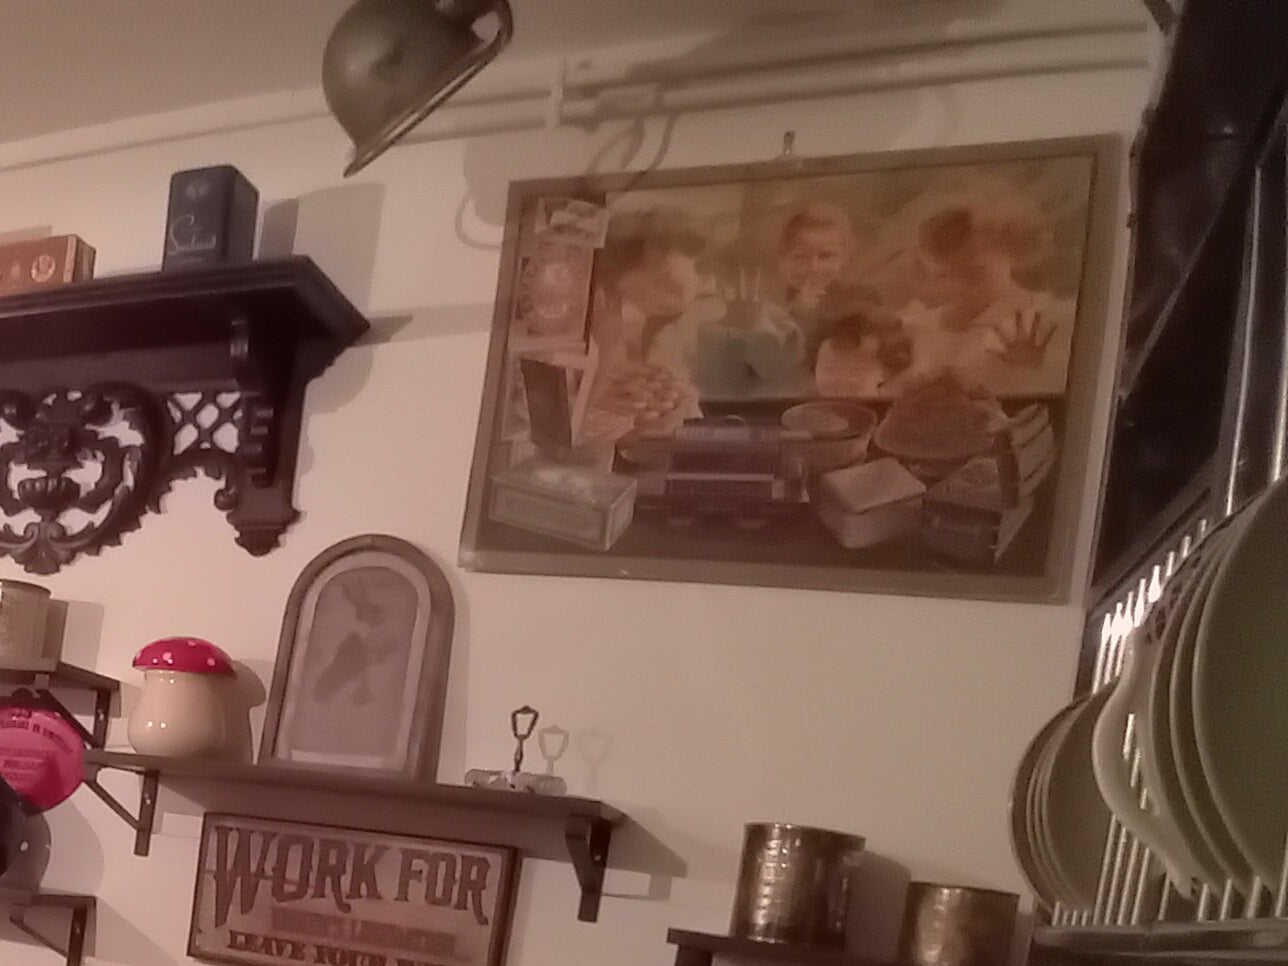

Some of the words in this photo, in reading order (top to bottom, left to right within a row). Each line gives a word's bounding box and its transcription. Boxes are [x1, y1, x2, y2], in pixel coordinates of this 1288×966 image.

[214, 825, 392, 929] WORK
[394, 848, 492, 927] FOR
[227, 929, 307, 961] LEAVE
